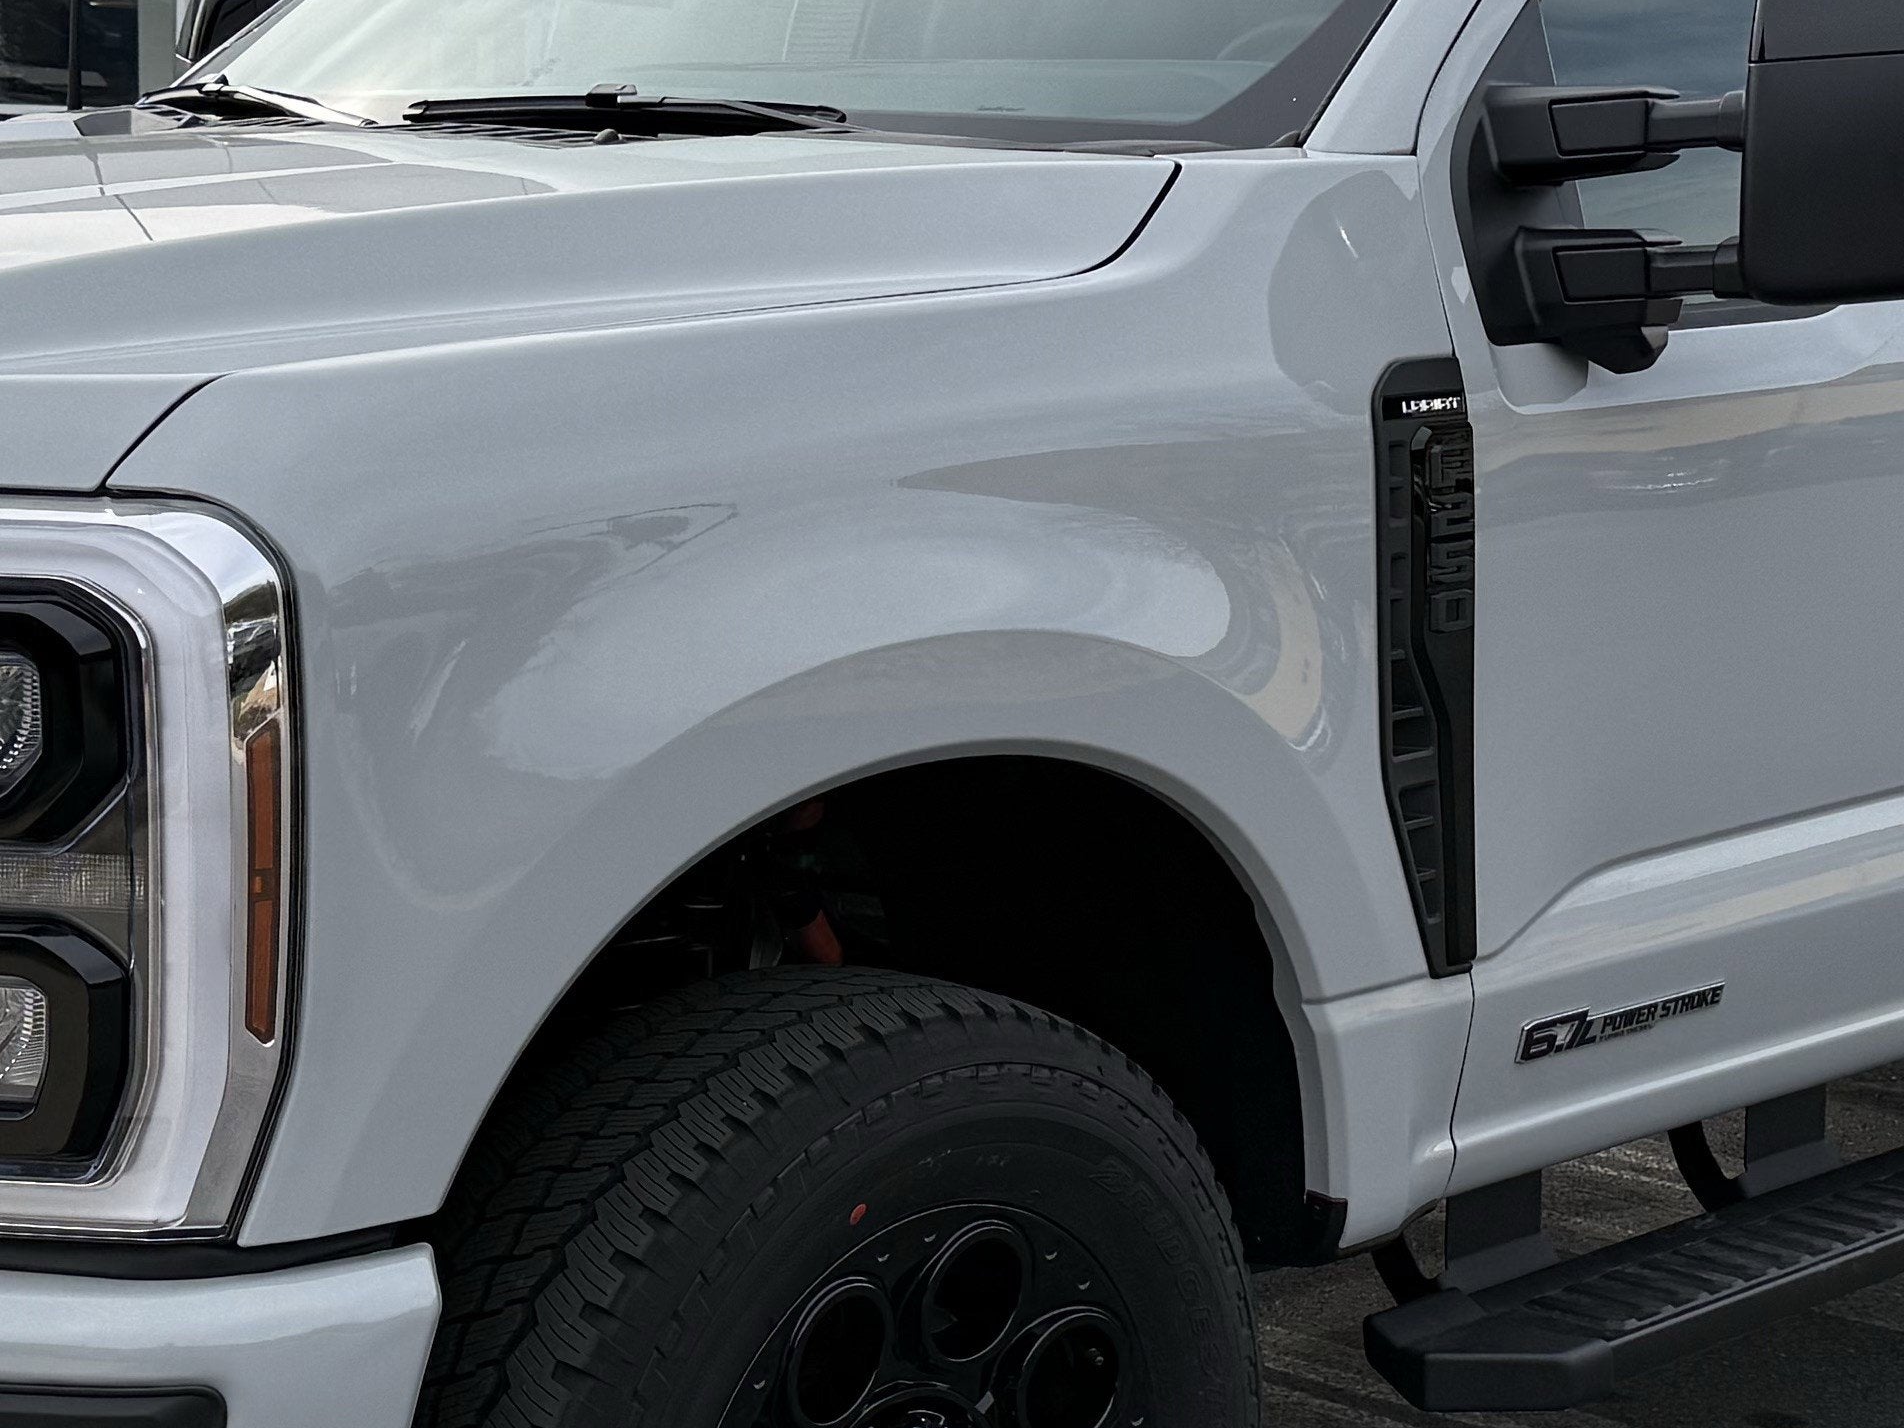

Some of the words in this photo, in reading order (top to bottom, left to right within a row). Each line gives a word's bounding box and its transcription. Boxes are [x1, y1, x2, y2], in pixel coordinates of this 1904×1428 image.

[1519, 1009, 1598, 1062] 6.7L
[1600, 1002, 1658, 1034] POWER
[1659, 984, 1725, 1019] STROKE
